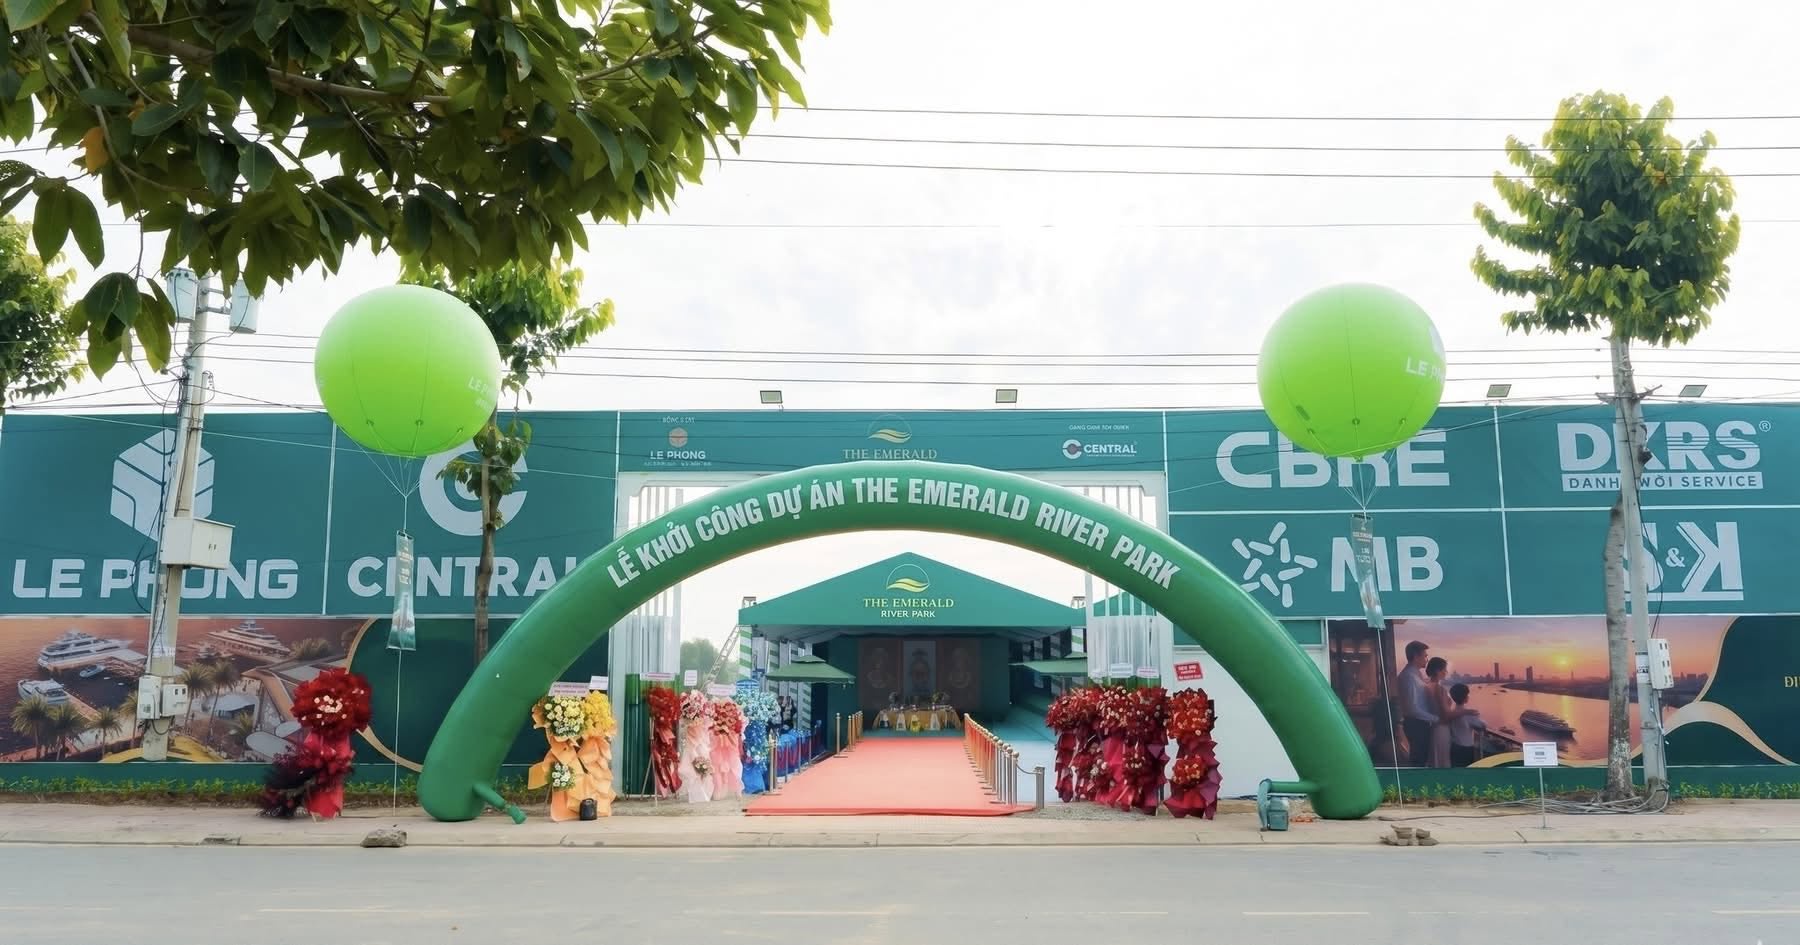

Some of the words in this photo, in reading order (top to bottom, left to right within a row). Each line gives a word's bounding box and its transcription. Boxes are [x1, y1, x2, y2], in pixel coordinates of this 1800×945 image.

[843, 449, 869, 459] THE
[874, 449, 937, 460] EMERALD
[1083, 444, 1137, 454] CENTRAL
[650, 450, 664, 460] LE
[667, 450, 706, 460] PHONG
[1569, 477, 1620, 489] DANH
[1681, 475, 1757, 487] SERVICE
[607, 546, 641, 588] LỄ
[635, 521, 695, 571] KHỞI
[695, 498, 764, 542] CÔNG
[767, 484, 802, 519] DỰ
[810, 479, 845, 511] ÁN
[852, 477, 899, 503] THE
[908, 478, 1030, 521] EMERALD
[1035, 502, 1110, 551] RIVER
[1110, 535, 1181, 590] PARK
[1331, 536, 1443, 592] MB
[12, 559, 85, 599] LE
[863, 598, 889, 608] THE
[893, 598, 954, 608] EMERALD
[881, 610, 909, 618] RIVER
[912, 610, 935, 618] PARK
[1784, 676, 1800, 688] ĐI
